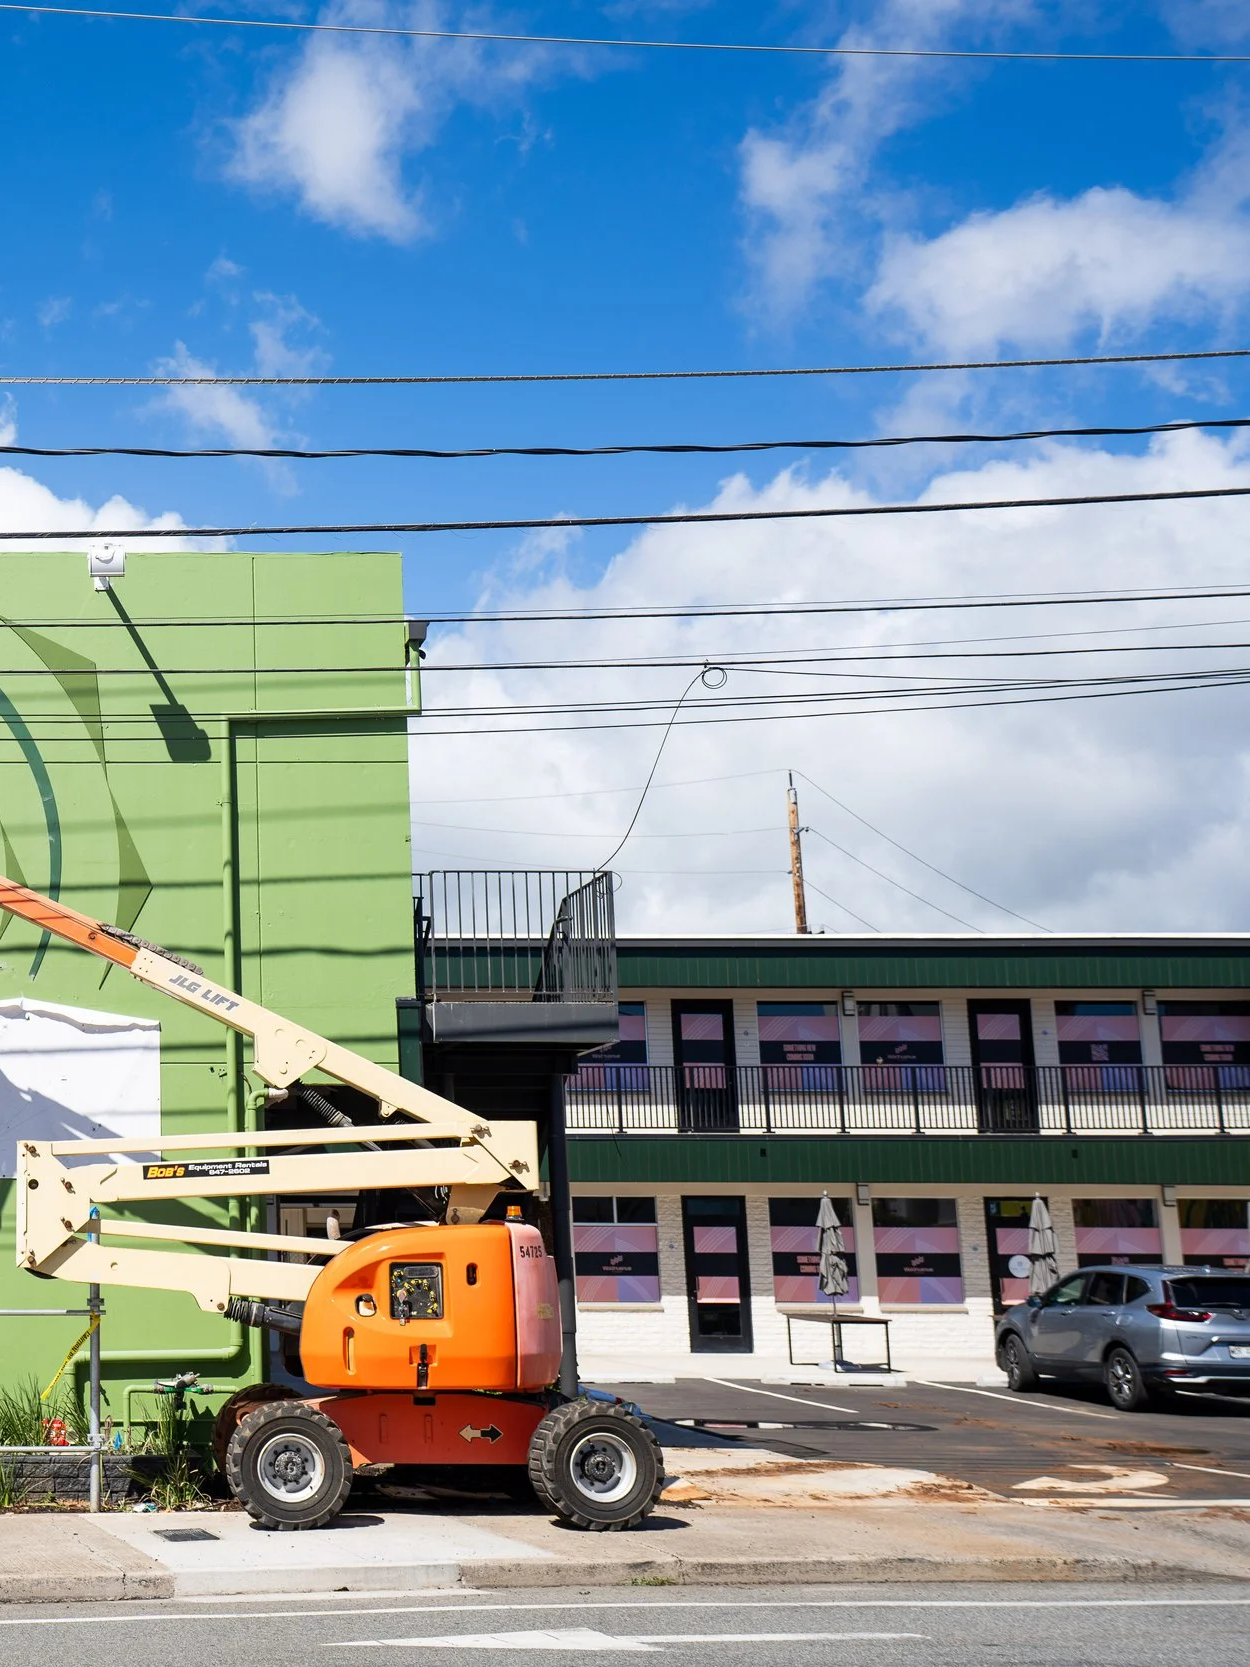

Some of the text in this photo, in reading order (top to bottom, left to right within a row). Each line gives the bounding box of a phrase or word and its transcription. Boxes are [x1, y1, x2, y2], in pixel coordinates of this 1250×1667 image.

[169, 975, 240, 1011] JLG LIFT
[188, 1161, 268, 1172] Equipment Rentals
[519, 1245, 542, 1259] 54725
